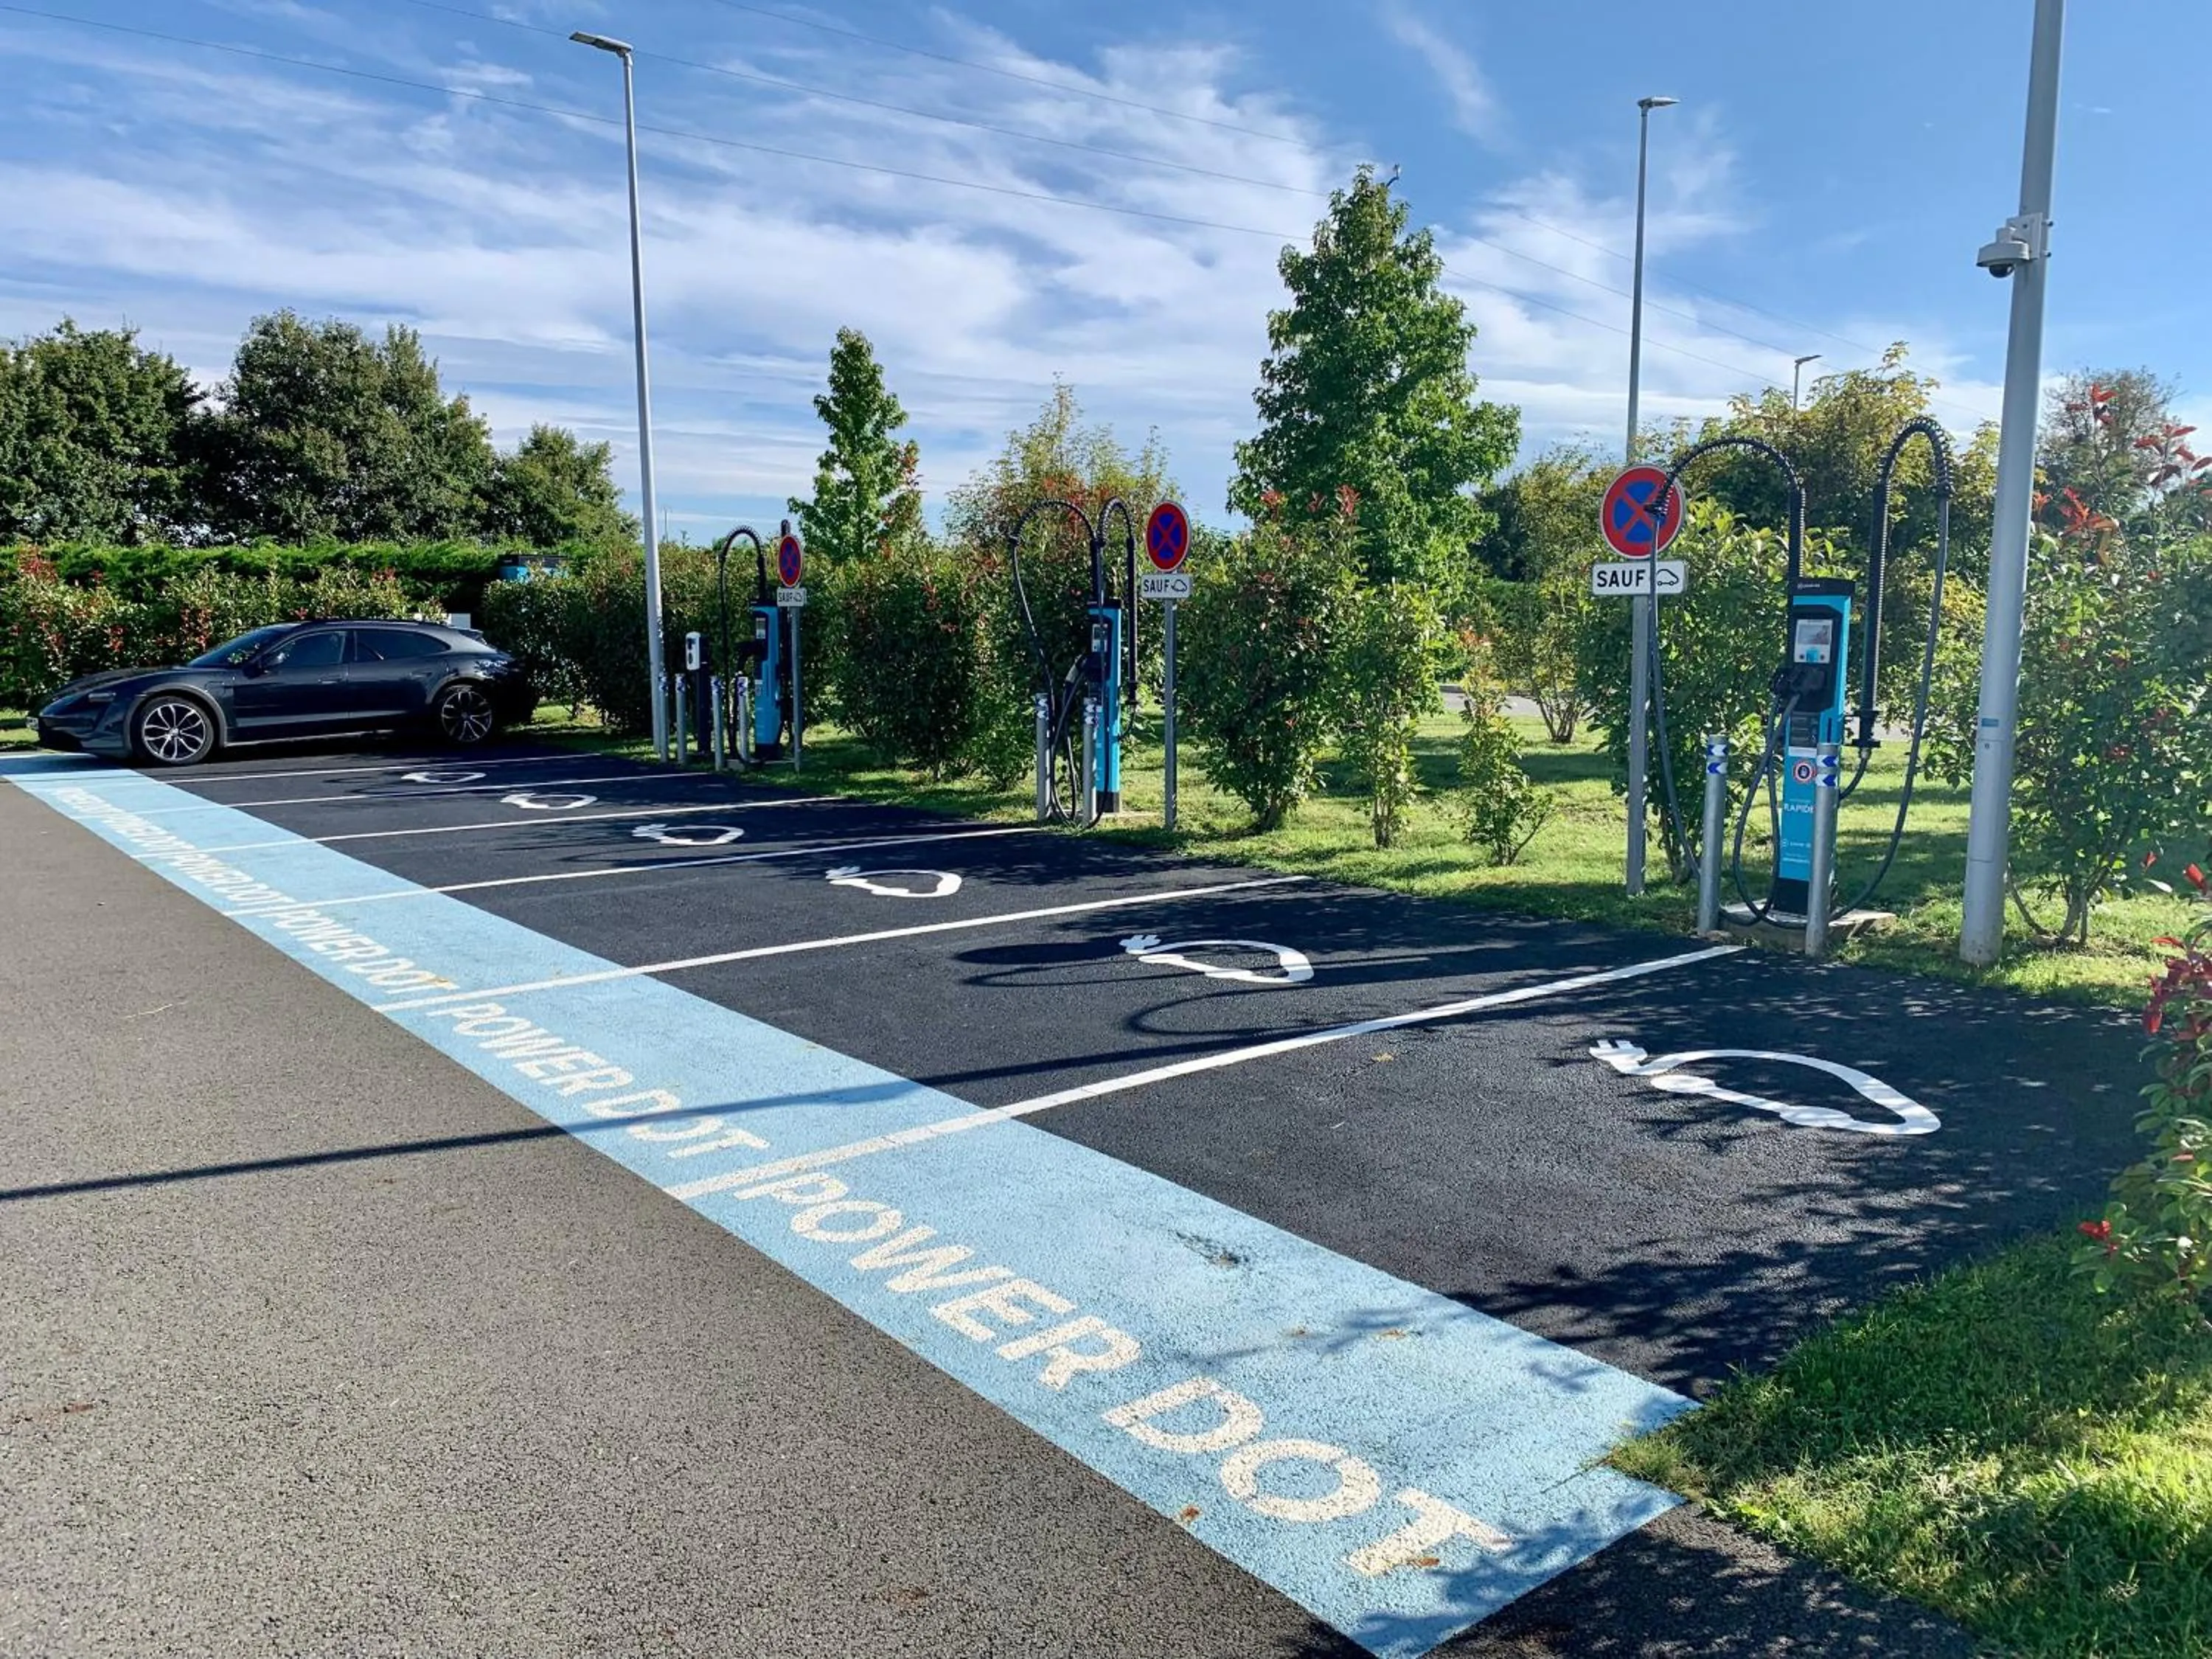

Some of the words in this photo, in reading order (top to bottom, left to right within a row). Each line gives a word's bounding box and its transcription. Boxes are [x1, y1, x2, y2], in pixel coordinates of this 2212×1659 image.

[1144, 579, 1170, 593] SAUF
[1596, 569, 1646, 588] SAUF
[257, 909, 390, 961] POWER
[342, 958, 461, 995] DOT
[425, 1002, 633, 1097] POWER
[582, 1089, 771, 1159] DOT
[733, 1172, 1142, 1391] POWER
[1102, 1375, 1513, 1577] DOT
